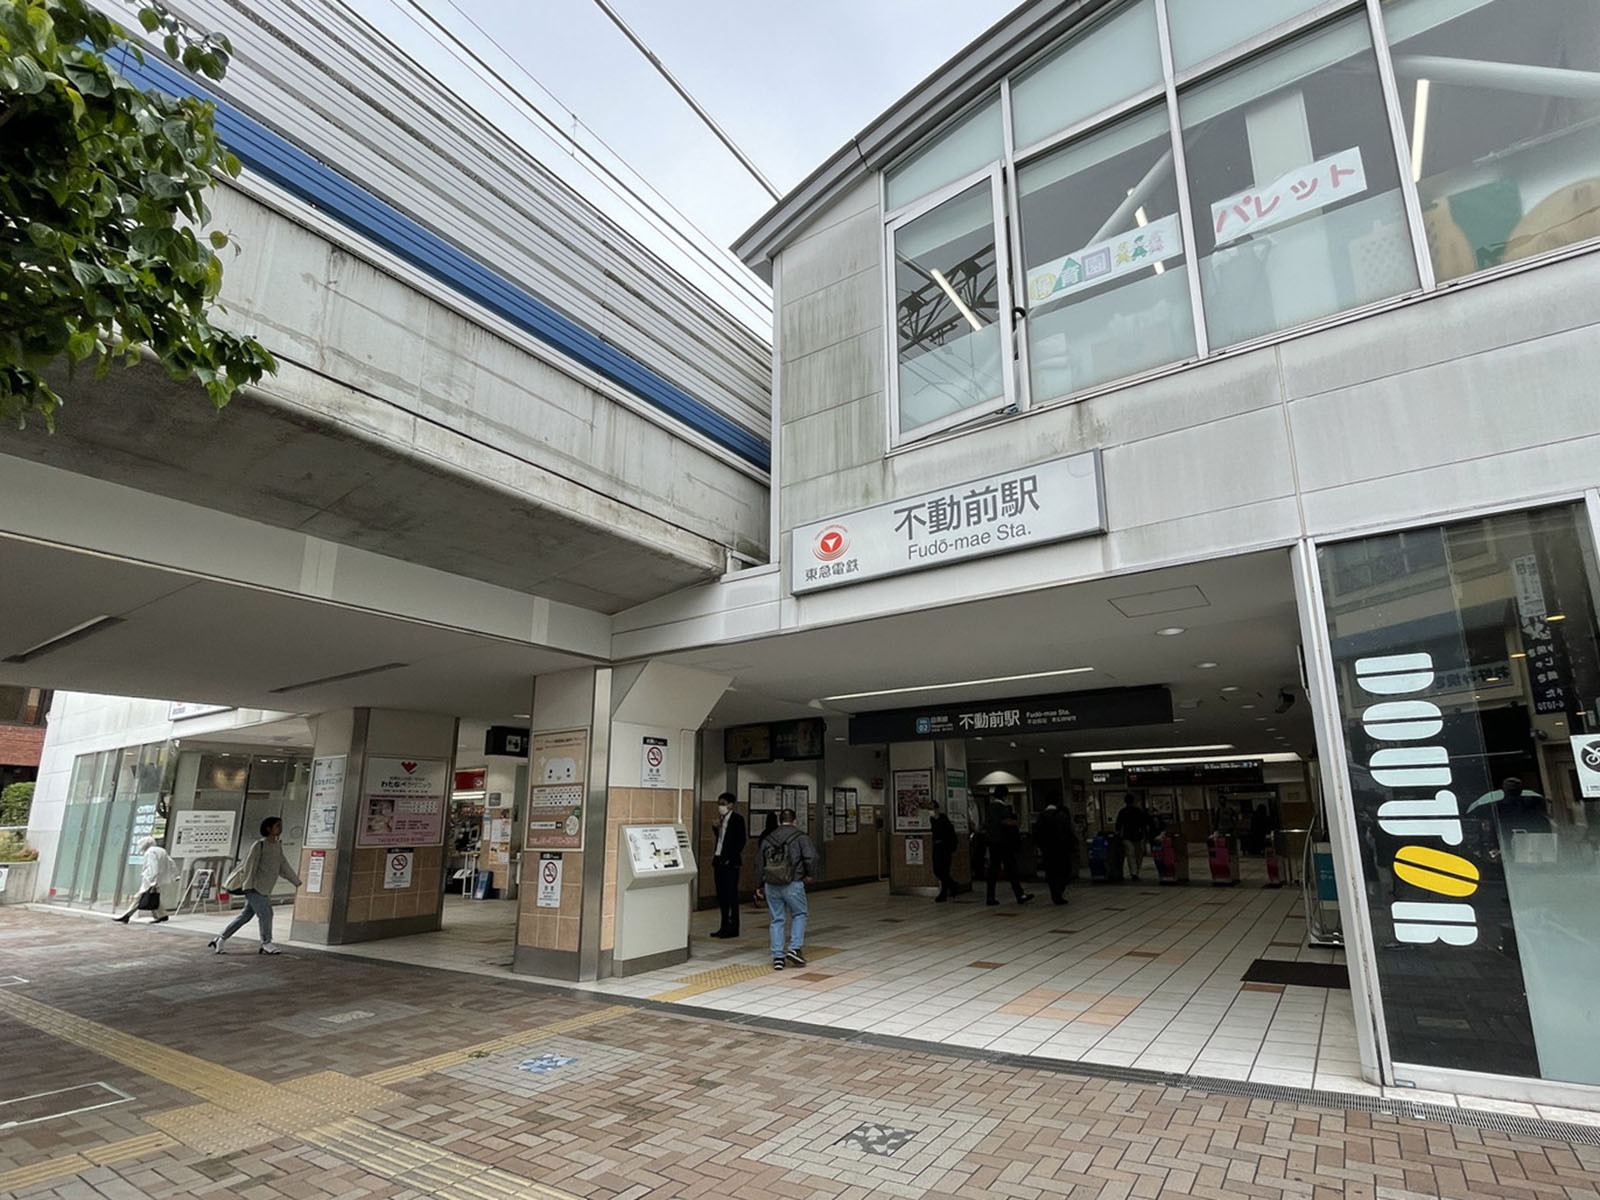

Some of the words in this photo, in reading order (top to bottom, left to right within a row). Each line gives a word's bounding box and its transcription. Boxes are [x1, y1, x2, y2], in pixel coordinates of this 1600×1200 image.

[1216, 164, 1356, 233] パレット
[893, 475, 1040, 541] 不動前駅
[907, 532, 991, 560] Fudō-mae
[996, 523, 1032, 541] Sta.
[805, 558, 860, 582] 東急電鉄
[959, 709, 1021, 730] 不動前駅
[1354, 652, 1481, 947] DOUTOR
